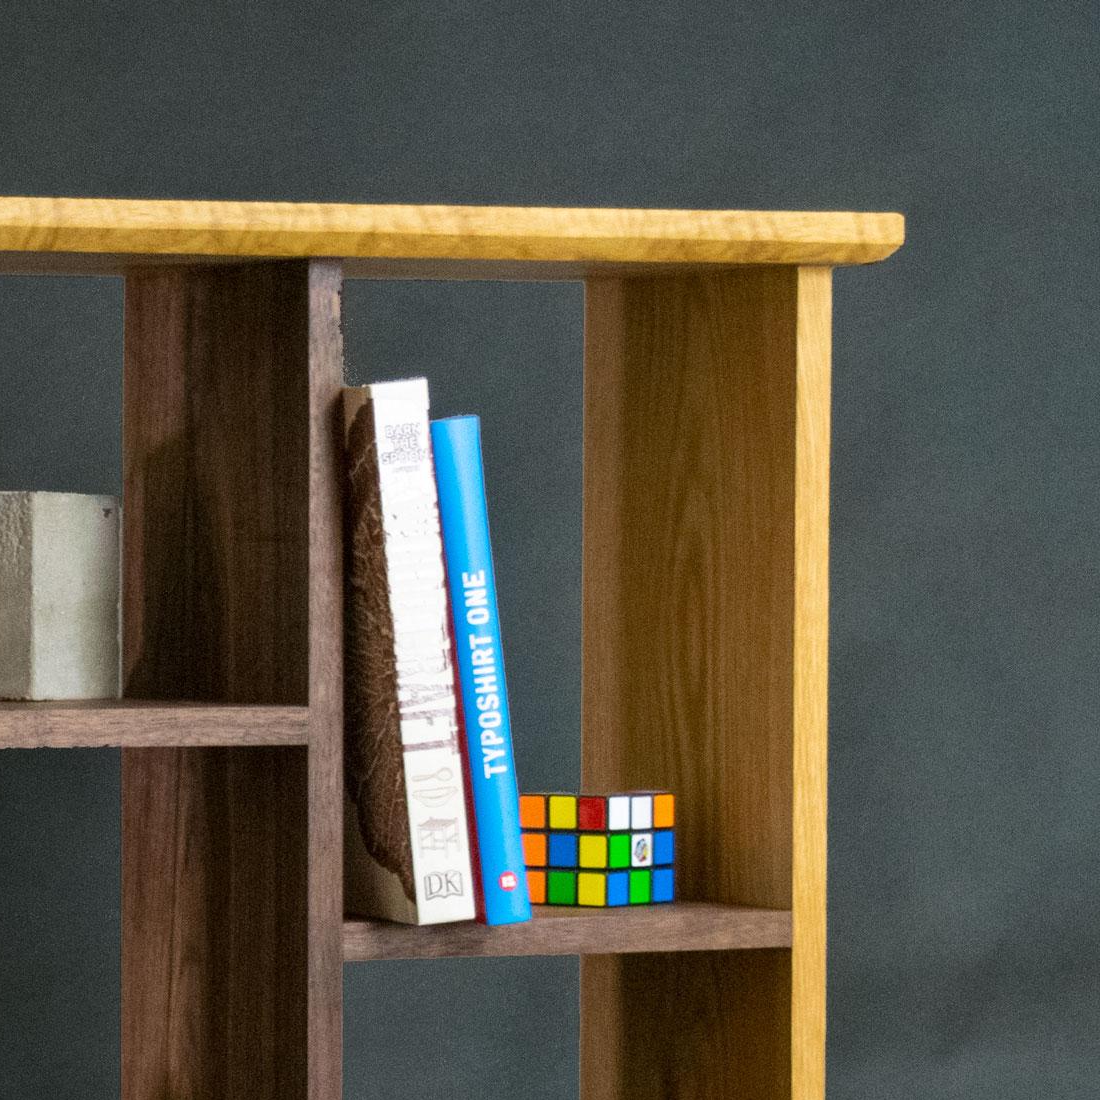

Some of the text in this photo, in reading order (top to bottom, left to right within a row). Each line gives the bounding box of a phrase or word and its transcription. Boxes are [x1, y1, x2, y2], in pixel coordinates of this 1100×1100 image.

[462, 569, 508, 779] TYPOSHIRT ONE
[428, 872, 460, 895] DK
